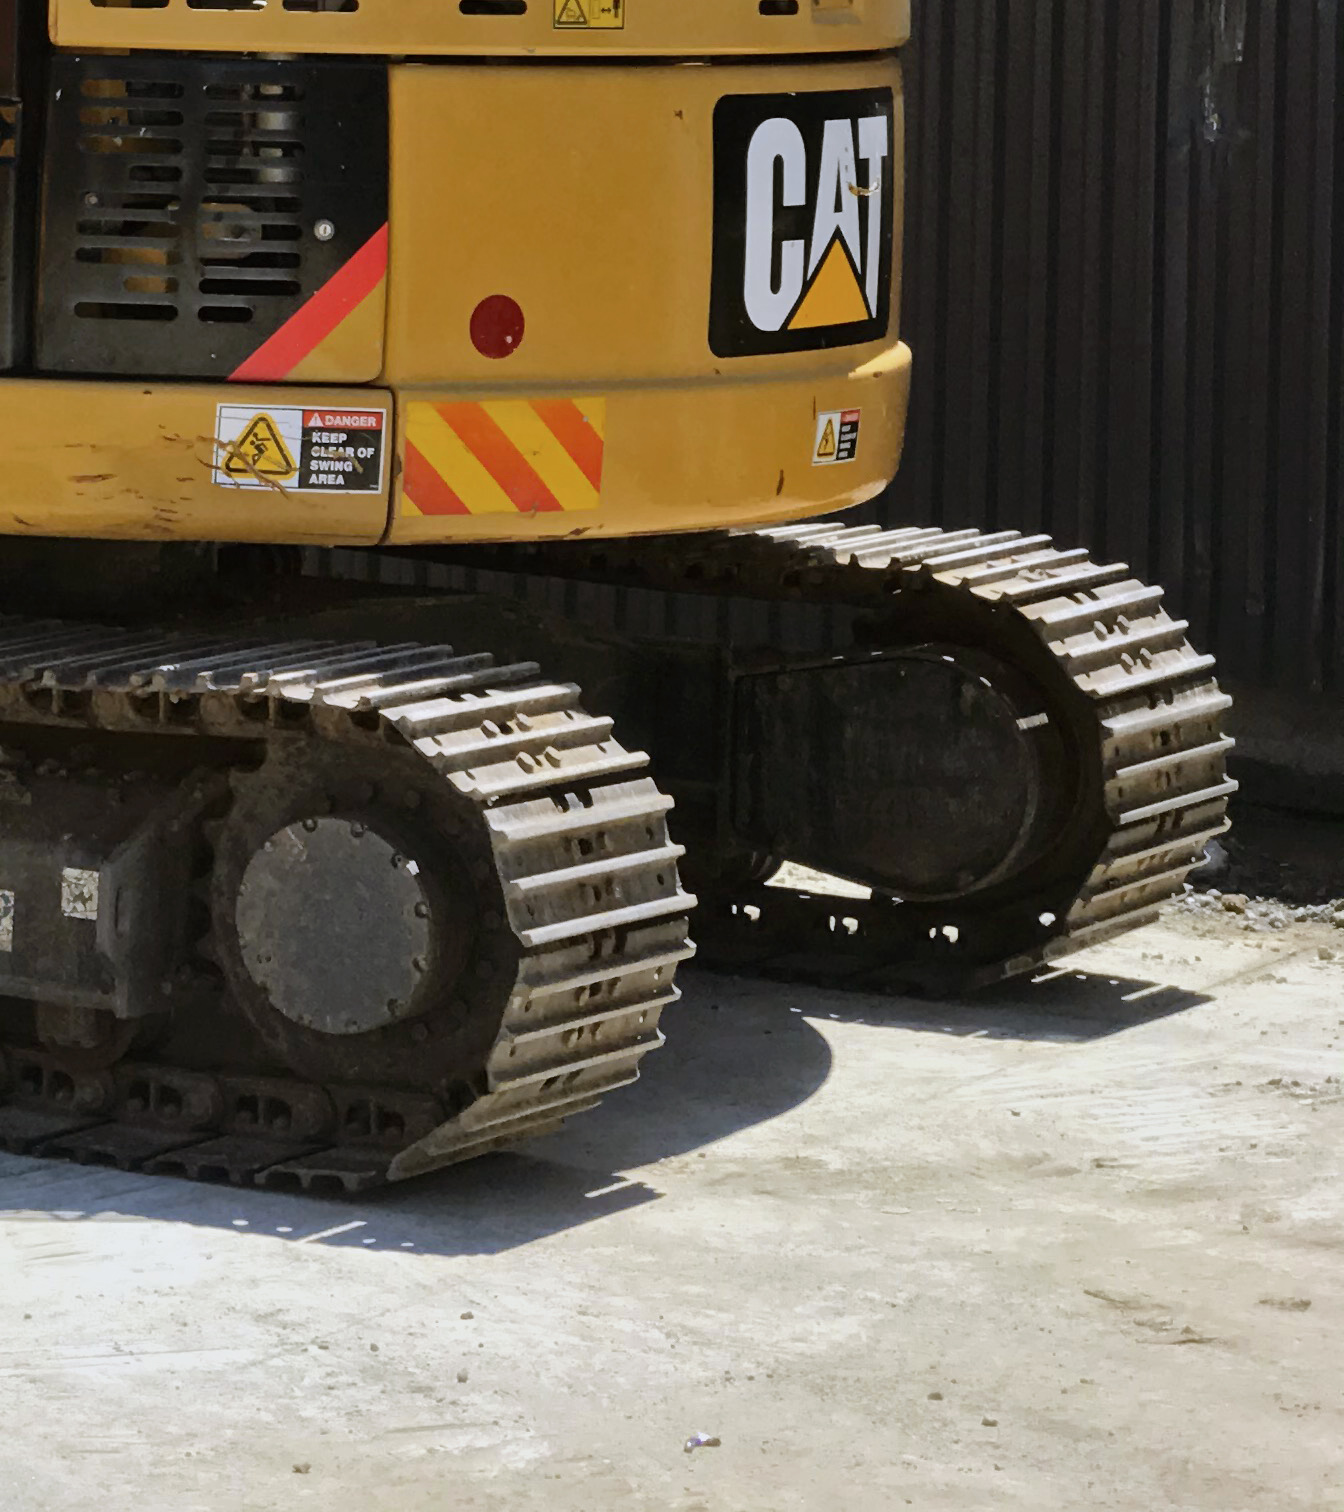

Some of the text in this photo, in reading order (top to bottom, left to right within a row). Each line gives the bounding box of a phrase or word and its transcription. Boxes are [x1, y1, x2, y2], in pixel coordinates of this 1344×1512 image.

[743, 115, 888, 332] CAT
[325, 414, 377, 427] DANGER
[311, 431, 348, 443] KEEP
[357, 447, 375, 458] OF
[309, 460, 353, 472] SWING
[308, 473, 345, 485] AREA
